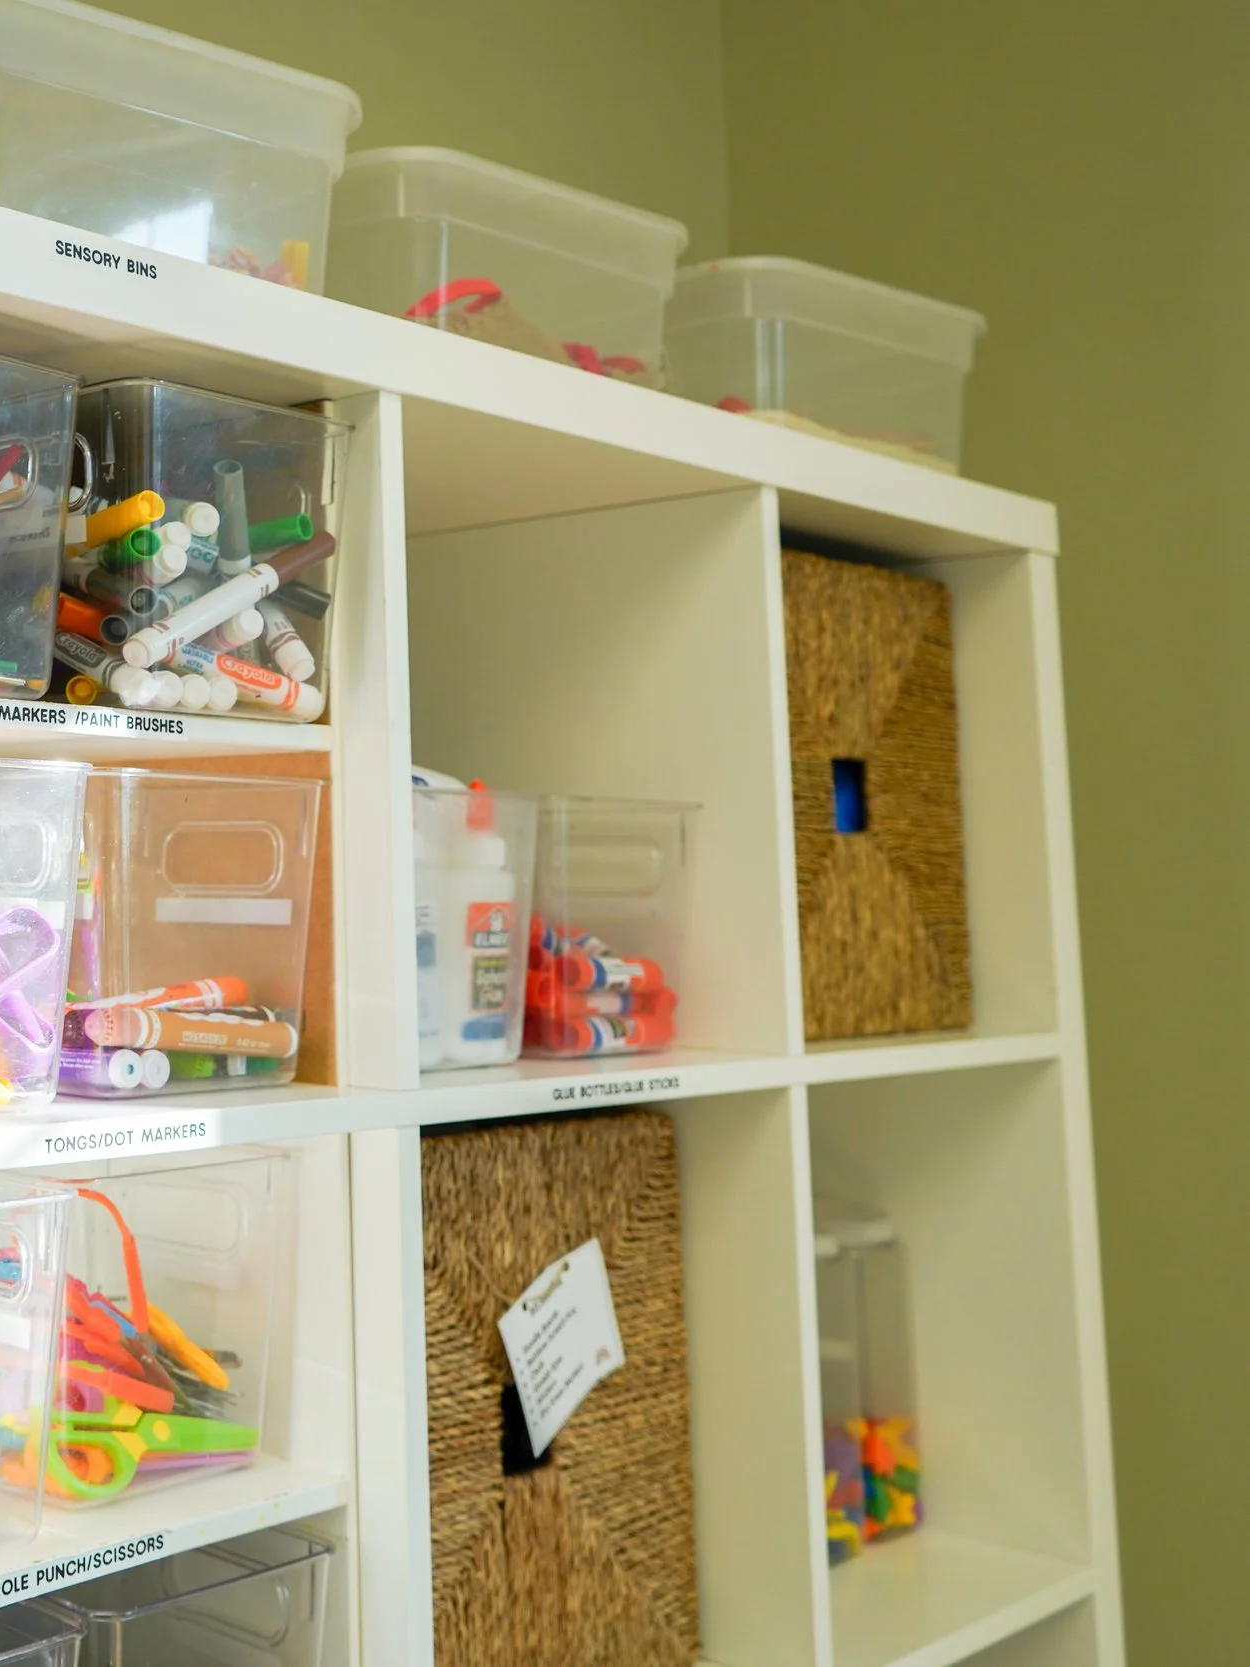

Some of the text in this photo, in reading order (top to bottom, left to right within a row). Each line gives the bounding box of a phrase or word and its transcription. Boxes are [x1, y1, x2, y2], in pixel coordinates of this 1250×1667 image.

[55, 239, 158, 280] SENSORY BINS
[57, 633, 100, 663] Crayola
[222, 657, 277, 685] Crayola
[126, 716, 184, 735] BRUSHES
[552, 1086, 576, 1101] GLUE
[44, 1122, 207, 1154] TONGS/DOT MARKERS
[36, 1534, 165, 1586] PUNCH/SCISSORS
